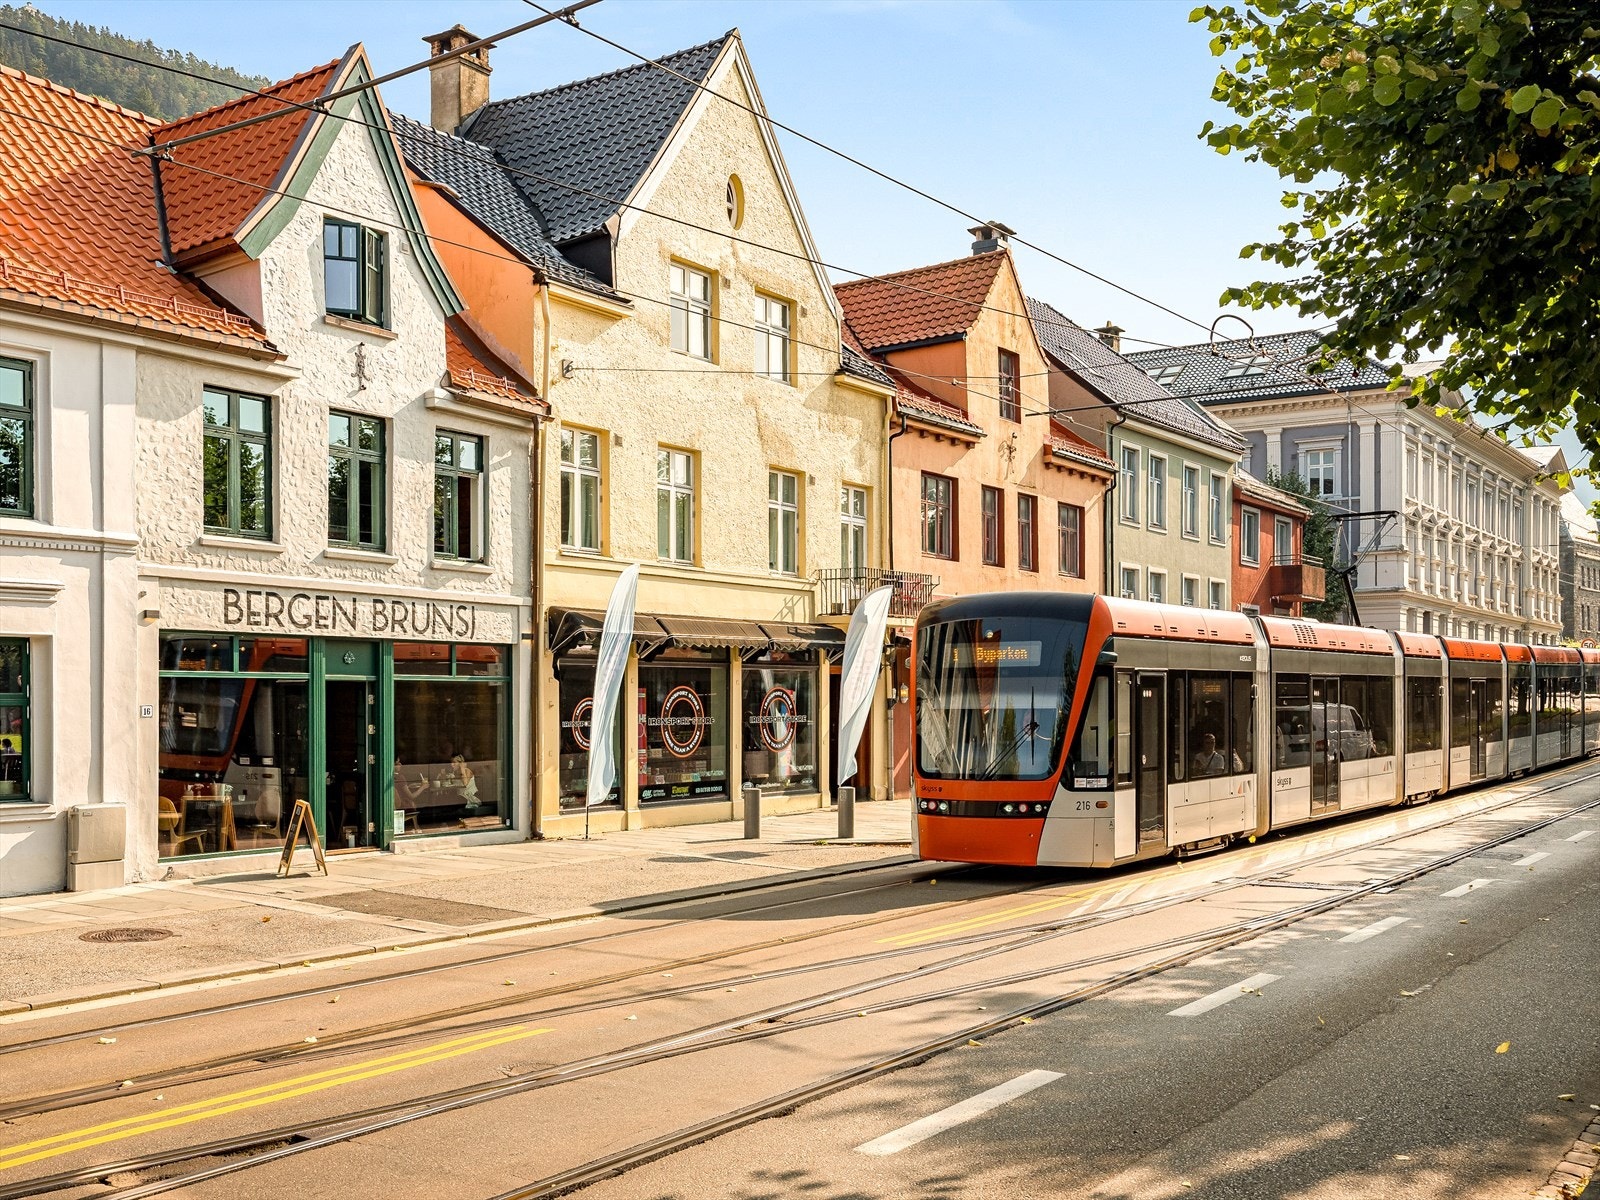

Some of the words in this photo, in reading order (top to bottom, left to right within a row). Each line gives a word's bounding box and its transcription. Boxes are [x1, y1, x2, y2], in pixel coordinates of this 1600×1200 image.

[223, 588, 357, 631] BERGEN
[372, 598, 476, 640] BRUNSJ
[976, 646, 1028, 663] Byparken
[143, 707, 151, 716] 16
[647, 716, 691, 726] IRONSPORT
[691, 716, 716, 725] STORE
[749, 715, 786, 724] IRONSPORT
[1076, 800, 1091, 811] 216
